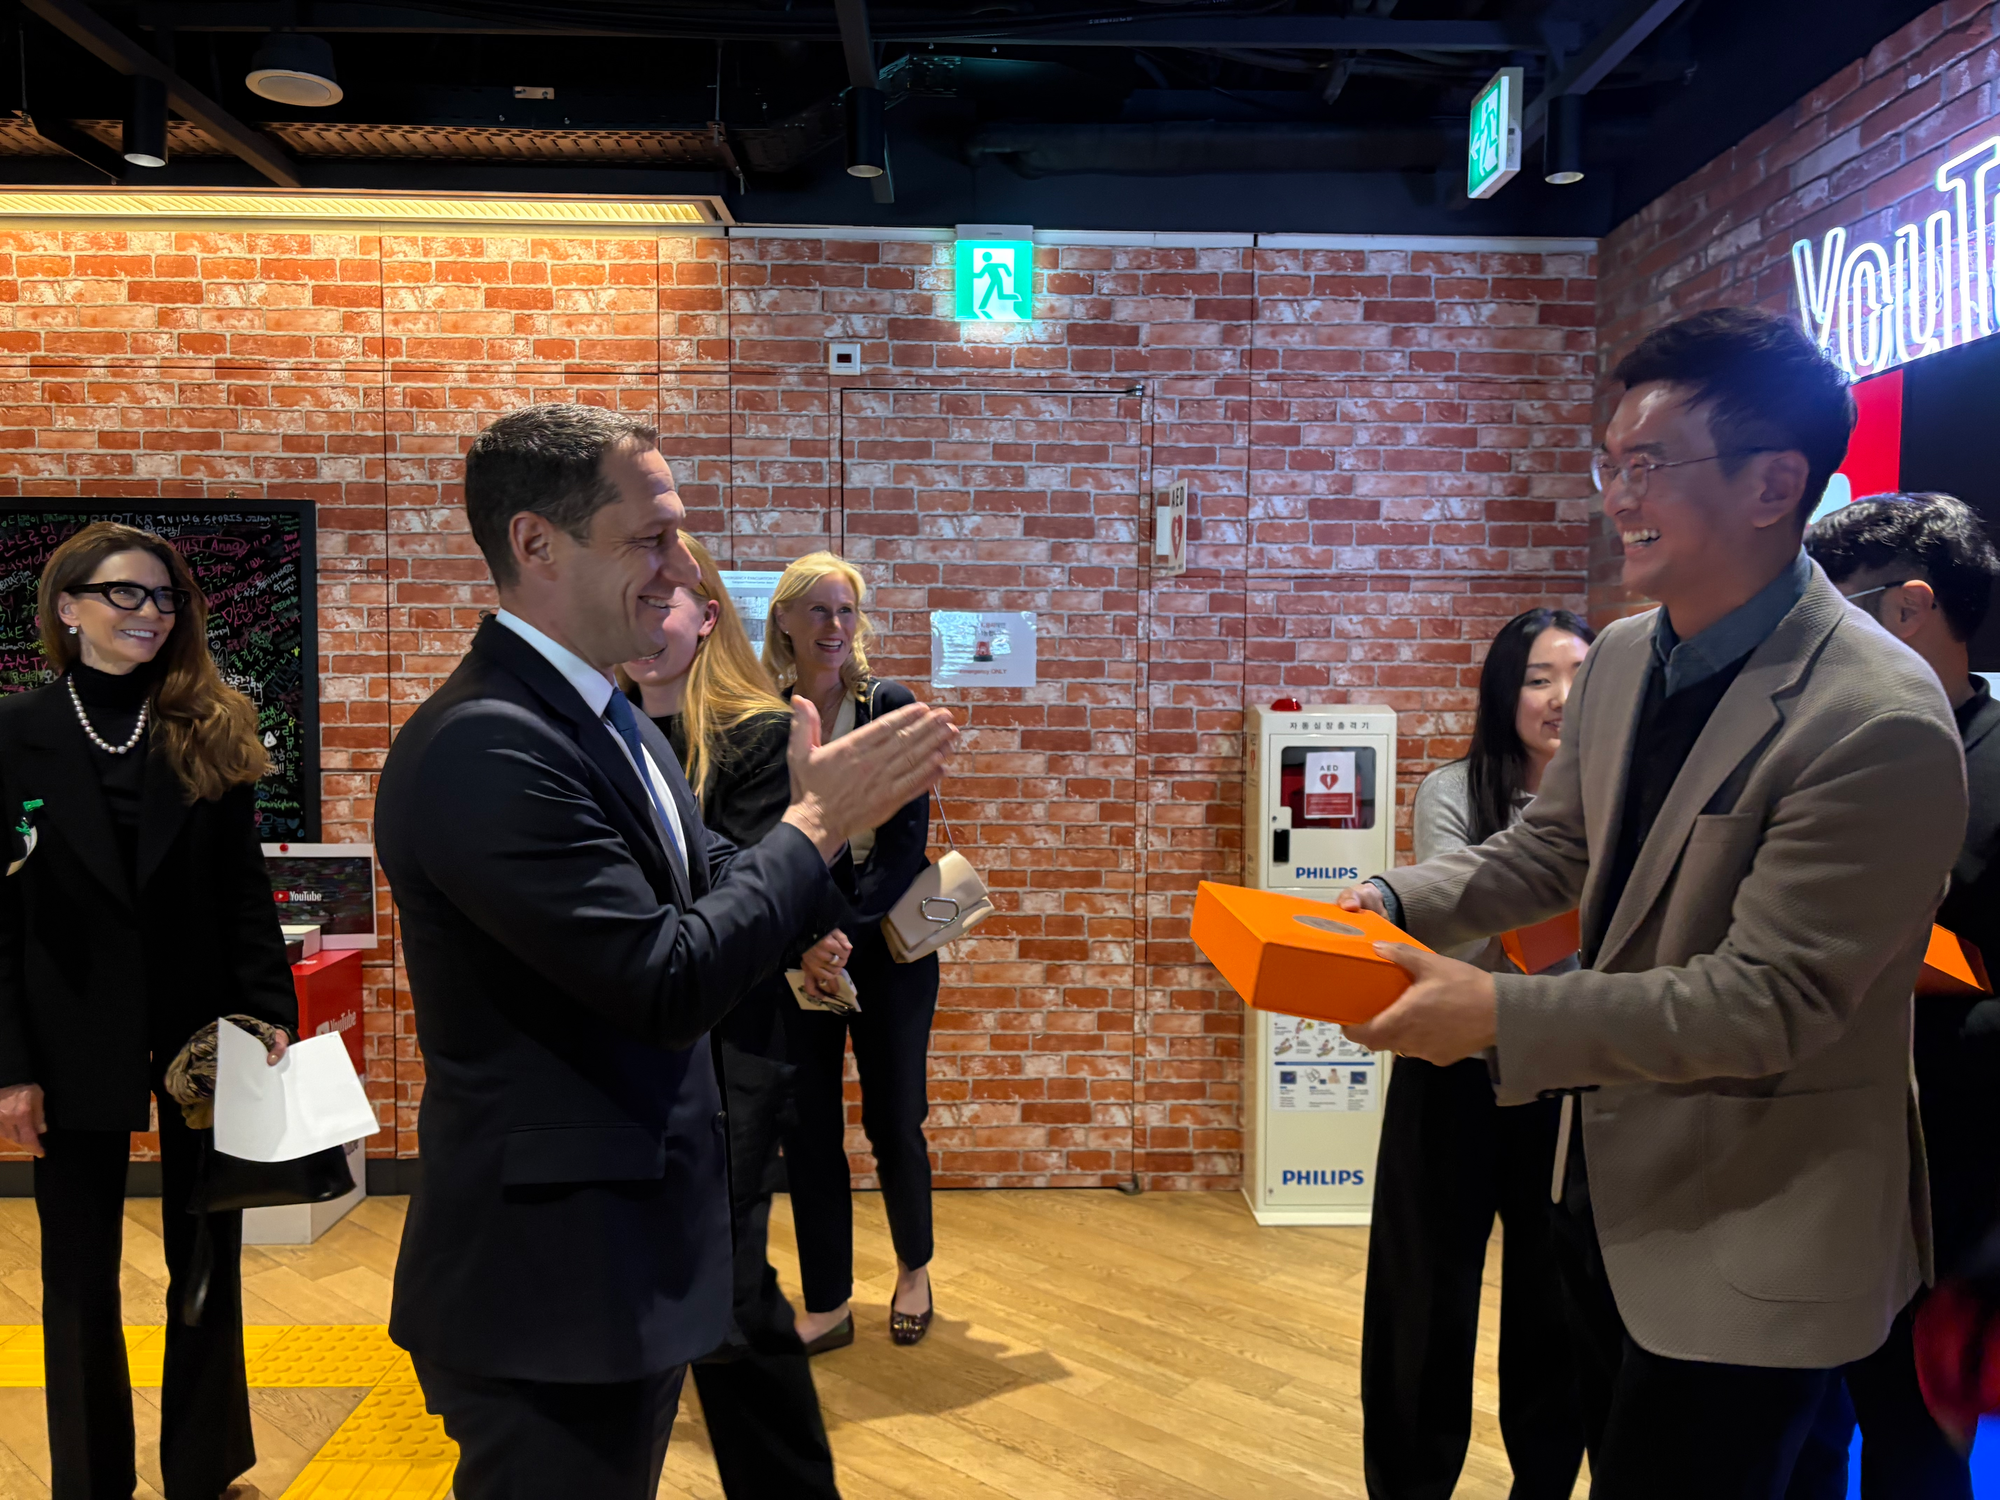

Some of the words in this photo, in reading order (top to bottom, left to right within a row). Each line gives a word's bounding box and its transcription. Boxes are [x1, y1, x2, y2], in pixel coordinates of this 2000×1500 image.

[1792, 135, 2000, 381] YouT
[1172, 486, 1185, 508] AED
[1320, 764, 1339, 772] AED
[1295, 867, 1358, 879] PHILIPS
[290, 890, 322, 902] YouTube
[1281, 1169, 1365, 1186] PHILIPS
